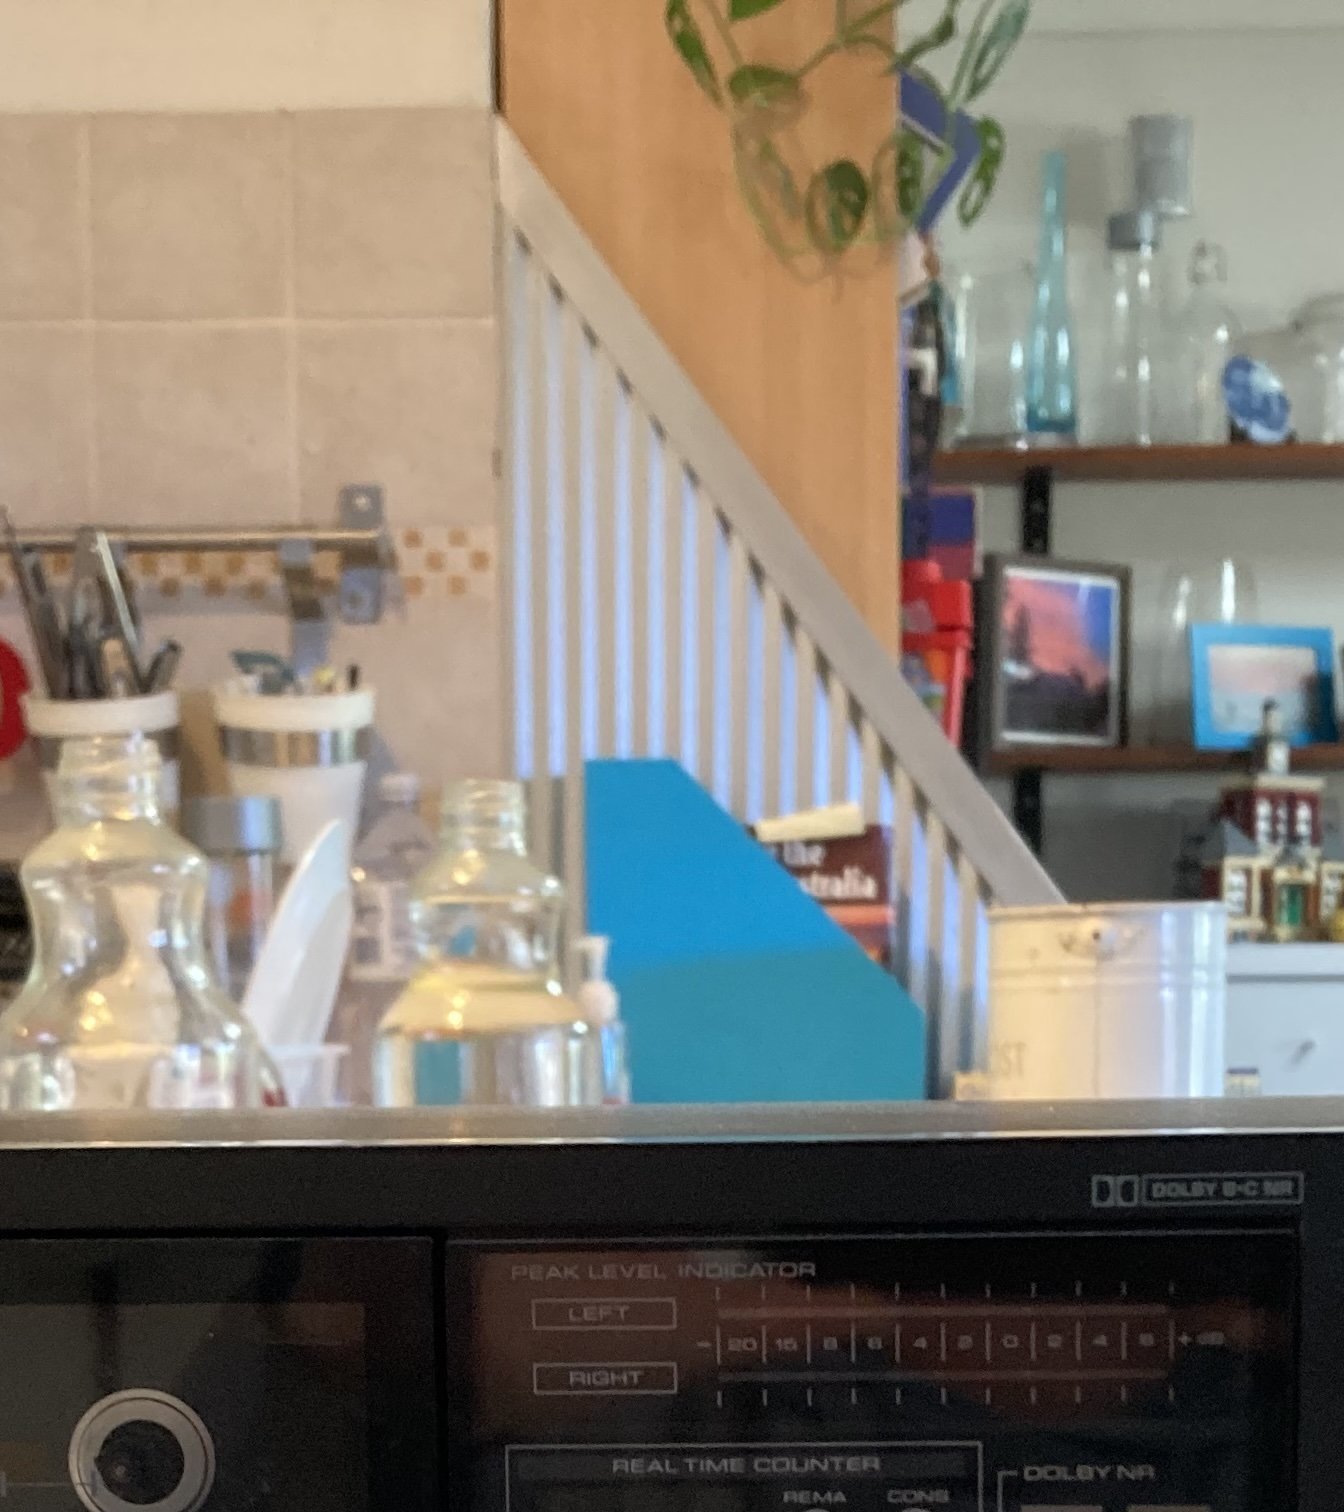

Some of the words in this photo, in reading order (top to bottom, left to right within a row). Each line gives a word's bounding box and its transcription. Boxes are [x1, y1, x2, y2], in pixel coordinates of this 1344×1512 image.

[799, 867, 878, 898] stralia
[992, 1041, 1026, 1078] ST
[1152, 1182, 1216, 1198] DOLBY
[511, 1263, 580, 1281] PEAK
[588, 1262, 667, 1280] LEVEL
[677, 1261, 817, 1280] INDICATOR
[568, 1304, 631, 1323] LEFT
[569, 1369, 644, 1387] RIGHT
[612, 1457, 679, 1475] REAL
[684, 1457, 745, 1474] TIME
[753, 1455, 881, 1473] COUNTER
[1023, 1464, 1111, 1482] DOLBY
[1116, 1464, 1156, 1481] NR
[782, 1489, 847, 1504] REMA
